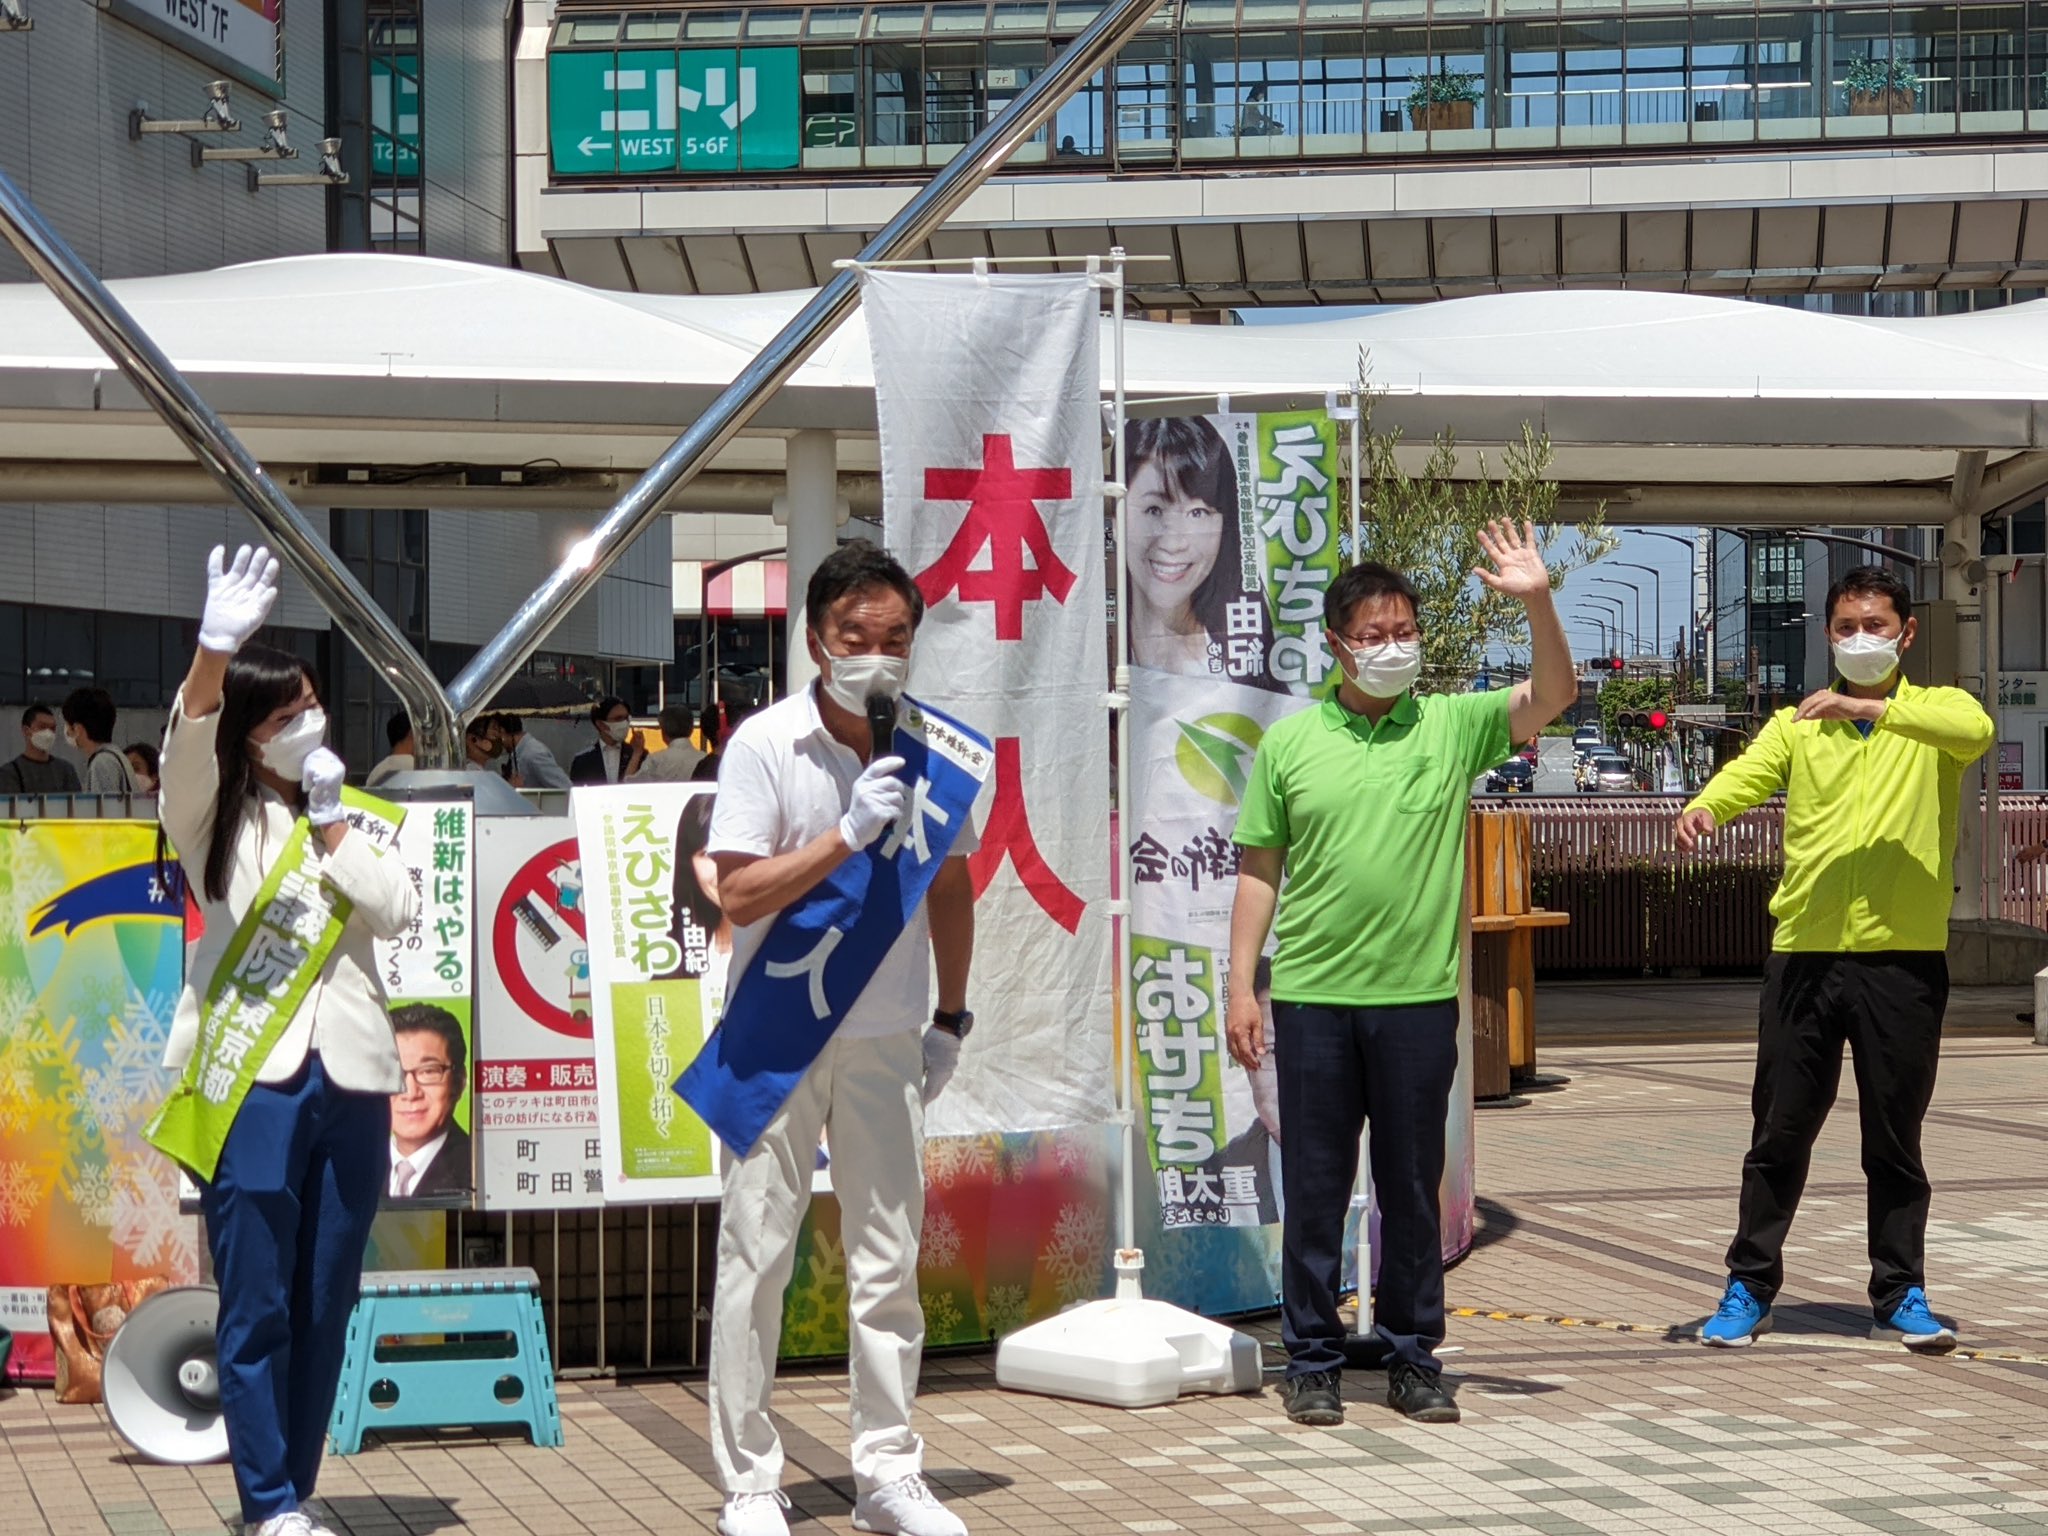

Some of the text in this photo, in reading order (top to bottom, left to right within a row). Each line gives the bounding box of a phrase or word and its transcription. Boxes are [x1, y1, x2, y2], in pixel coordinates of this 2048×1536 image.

[211, 4, 229, 43] 7F
[601, 67, 757, 131] ニトリ
[621, 138, 674, 156] WEST
[407, 866, 424, 951] 改守の
[433, 807, 466, 993] 維新は、やる。
[621, 803, 680, 974] えびさわ
[683, 923, 709, 973] 由紀
[482, 1063, 594, 1088] 演奏・販売
[647, 996, 674, 1137] 日本を切り拓く
